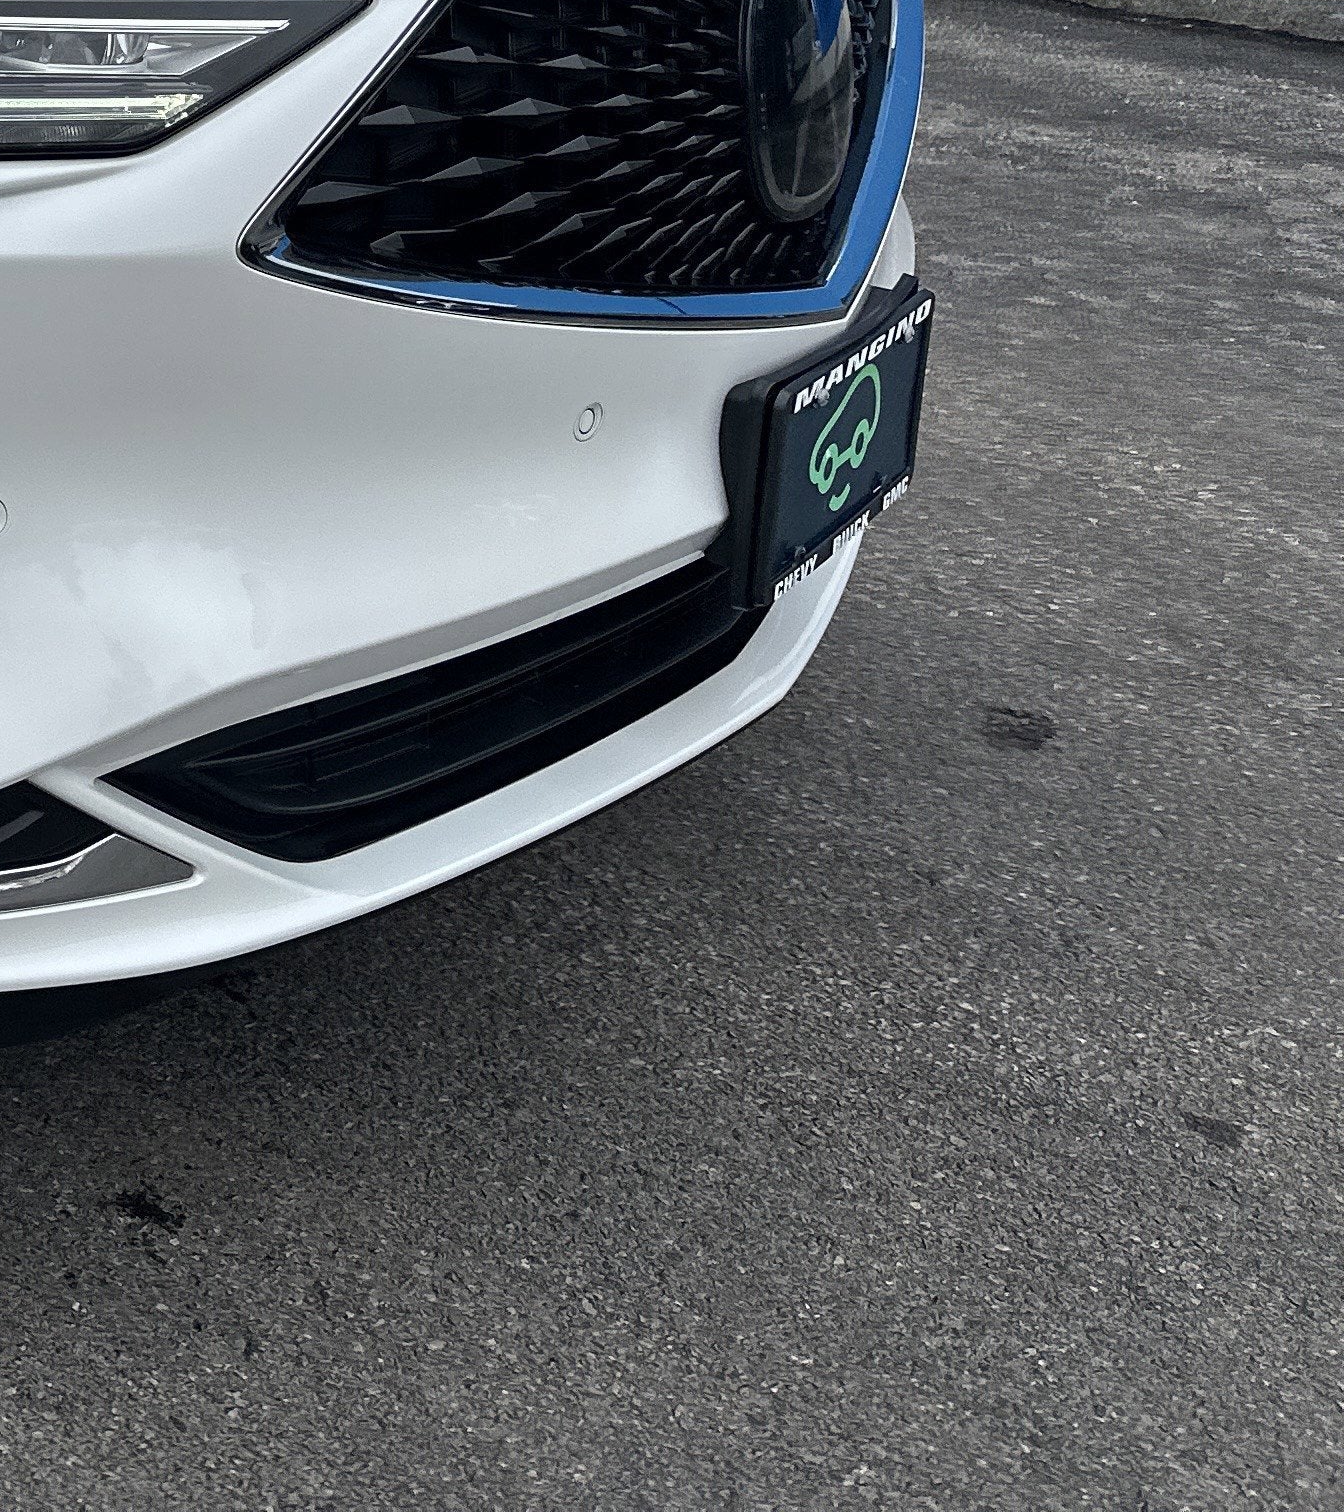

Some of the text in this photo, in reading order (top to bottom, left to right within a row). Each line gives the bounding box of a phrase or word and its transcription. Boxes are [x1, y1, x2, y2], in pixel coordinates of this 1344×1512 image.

[793, 298, 932, 414] MANGINO
[773, 554, 818, 601] CHEVY
[882, 475, 909, 511] GMC
